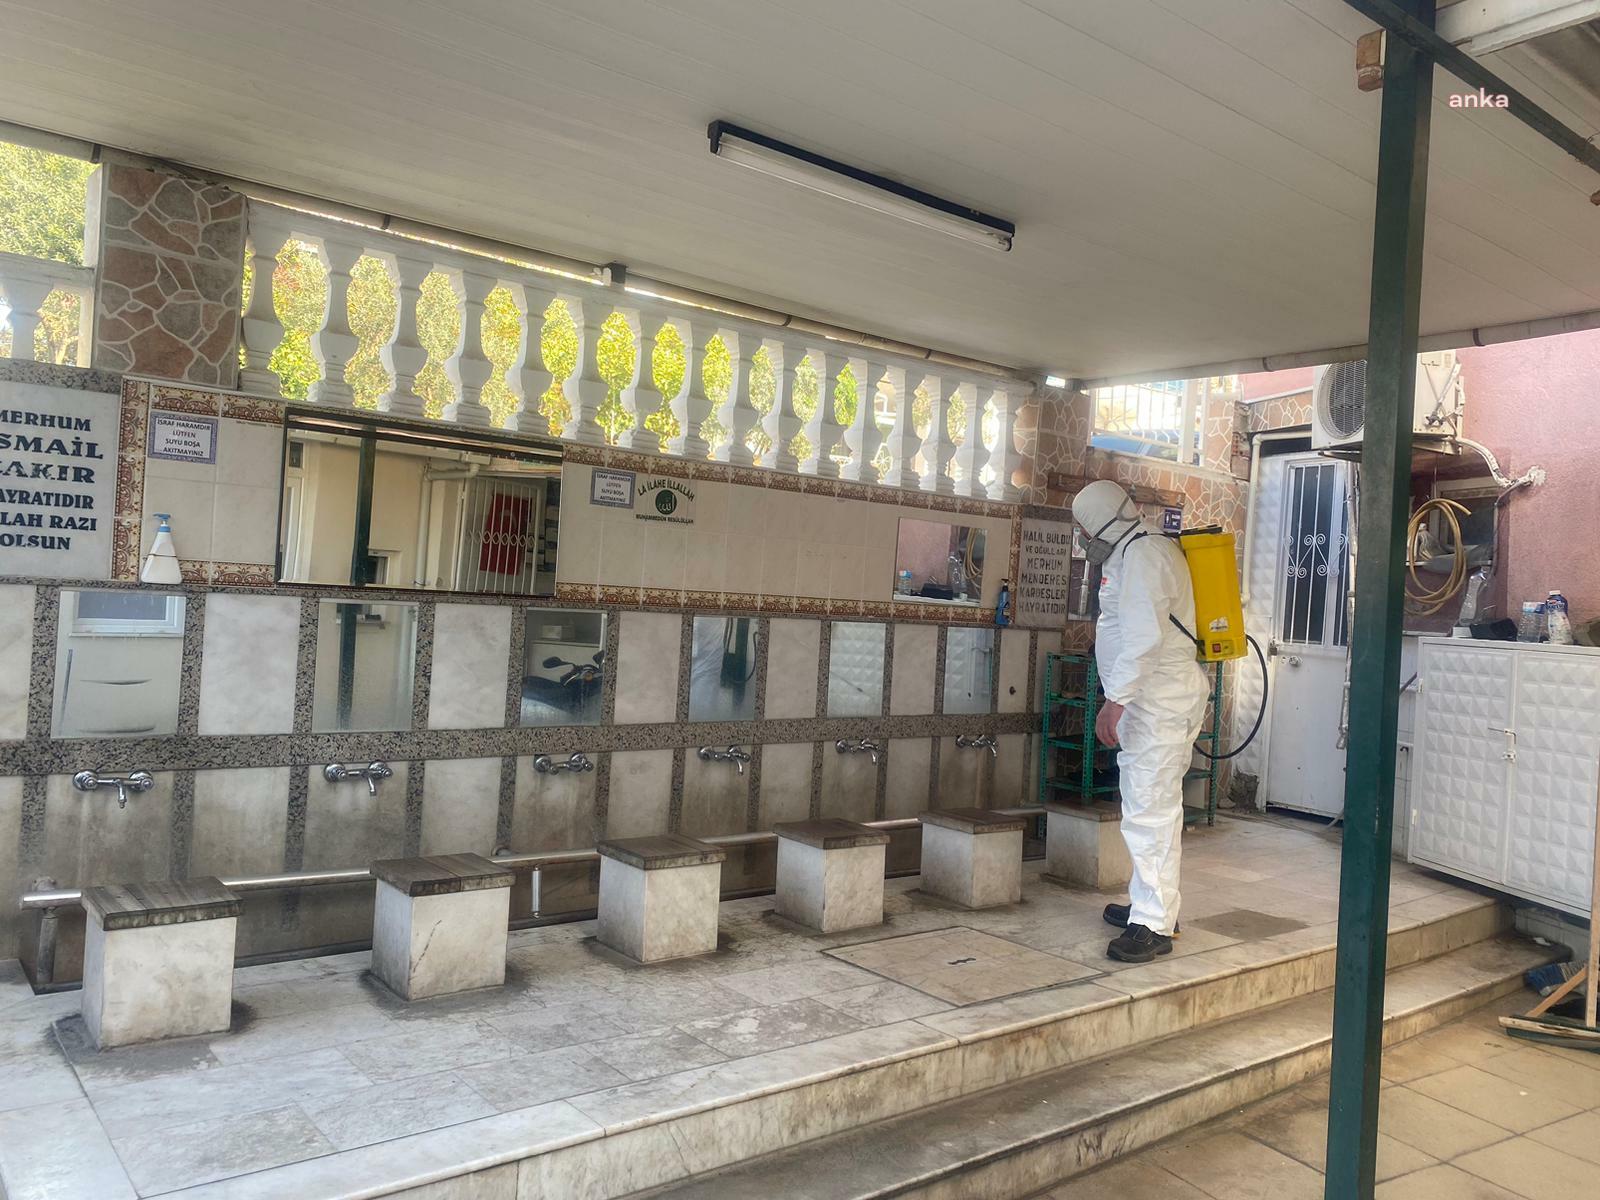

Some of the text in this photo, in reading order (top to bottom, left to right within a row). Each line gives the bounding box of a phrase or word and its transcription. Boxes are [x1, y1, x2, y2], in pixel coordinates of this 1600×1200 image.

[0, 460, 95, 483] AKIR
[49, 514, 97, 531] RAZI
[0, 533, 71, 550] OLSUN
